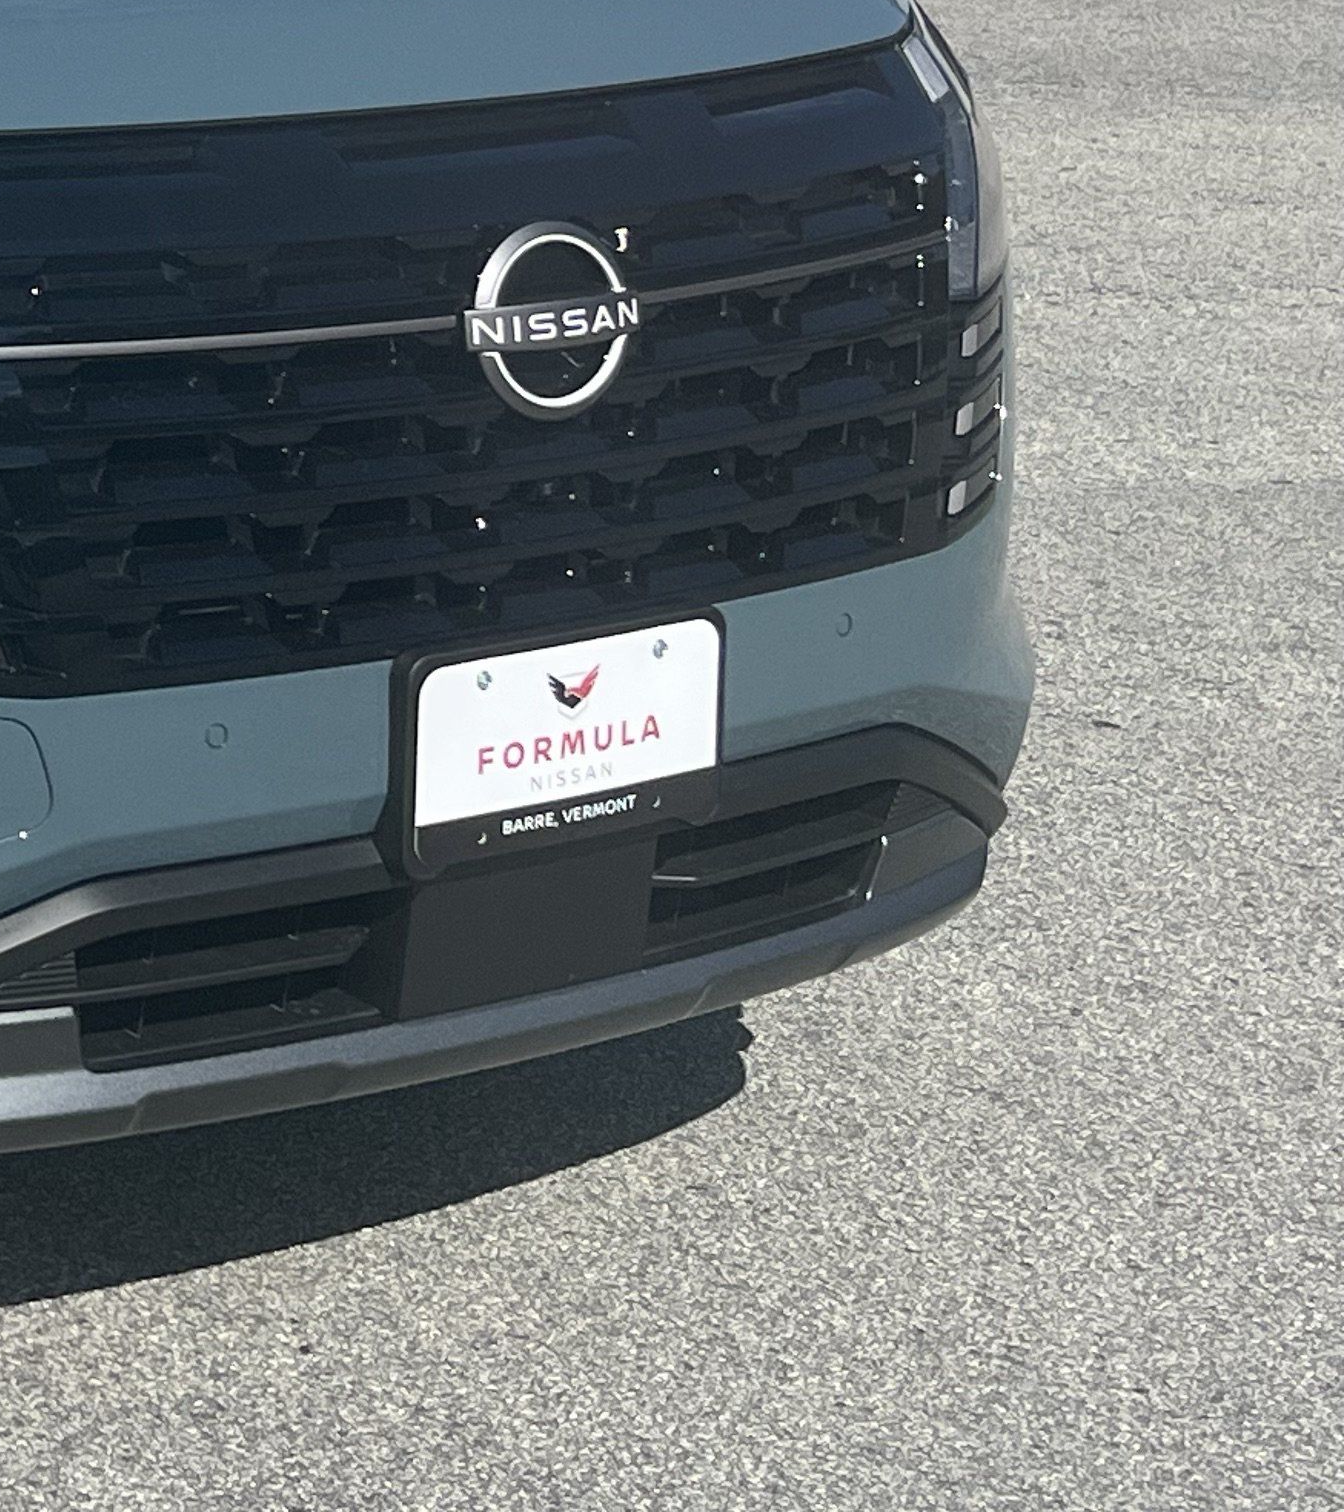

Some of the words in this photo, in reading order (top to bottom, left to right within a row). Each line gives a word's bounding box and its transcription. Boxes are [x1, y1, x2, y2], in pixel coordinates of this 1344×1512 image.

[471, 298, 639, 345] NISSAN
[477, 714, 661, 775] FORMULA
[529, 761, 613, 794] NISSAN
[561, 793, 638, 824] VERMONT
